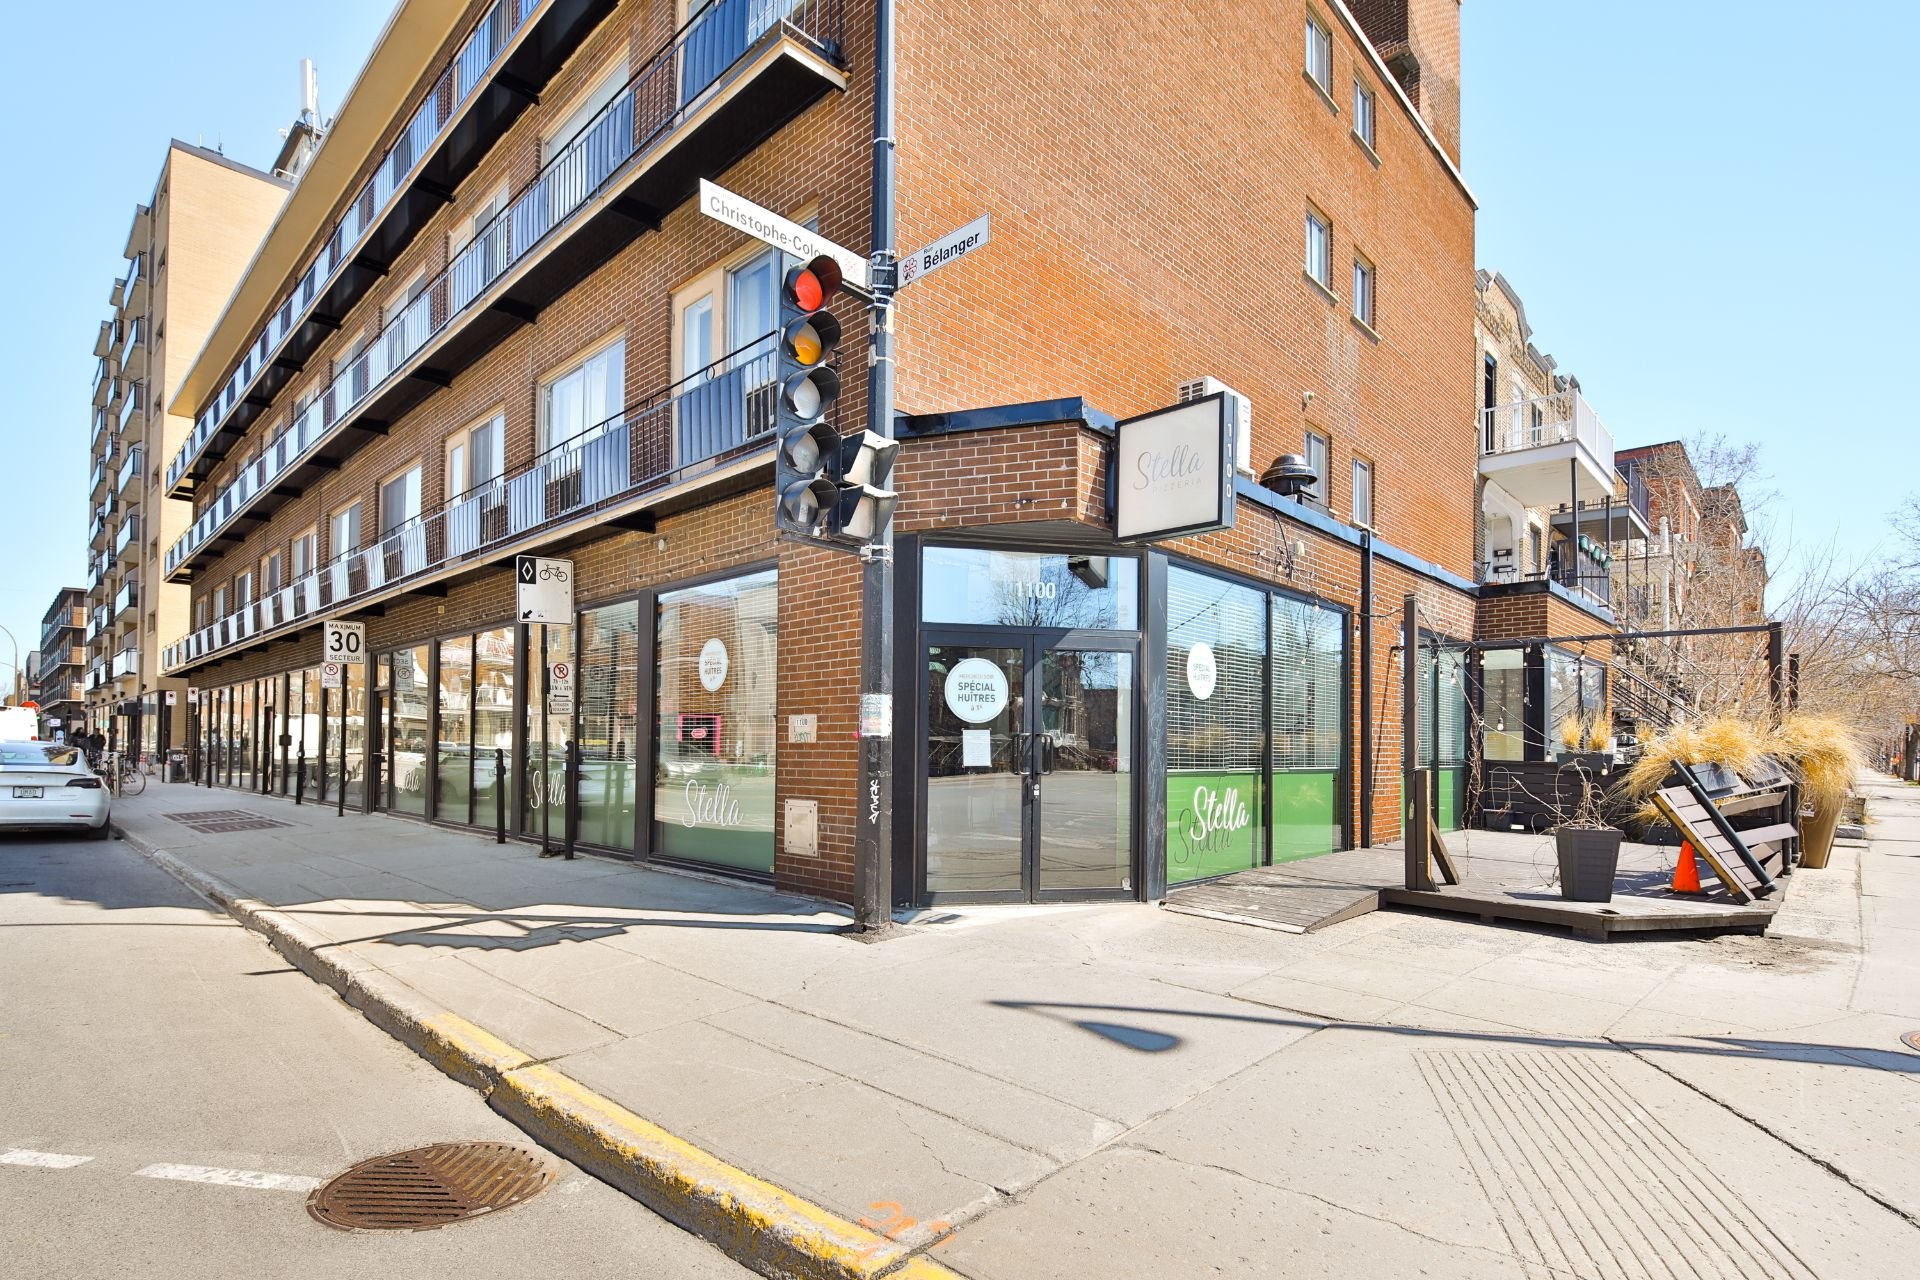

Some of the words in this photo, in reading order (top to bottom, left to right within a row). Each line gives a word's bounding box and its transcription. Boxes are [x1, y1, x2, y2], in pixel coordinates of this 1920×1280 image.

[710, 195, 838, 263] Christophe-Colo
[923, 232, 980, 270] Bélanger
[1133, 444, 1206, 491] Stella
[1225, 423, 1233, 498] 1100
[1017, 582, 1056, 599] 1100
[328, 623, 361, 631] MAXIMUM
[329, 630, 360, 653] 30
[329, 654, 361, 662] SECTEUR
[957, 680, 996, 692] SPÉCIAL
[957, 691, 996, 703] HUÎTRES
[682, 779, 743, 828] Stella
[1190, 786, 1250, 840] Stella
